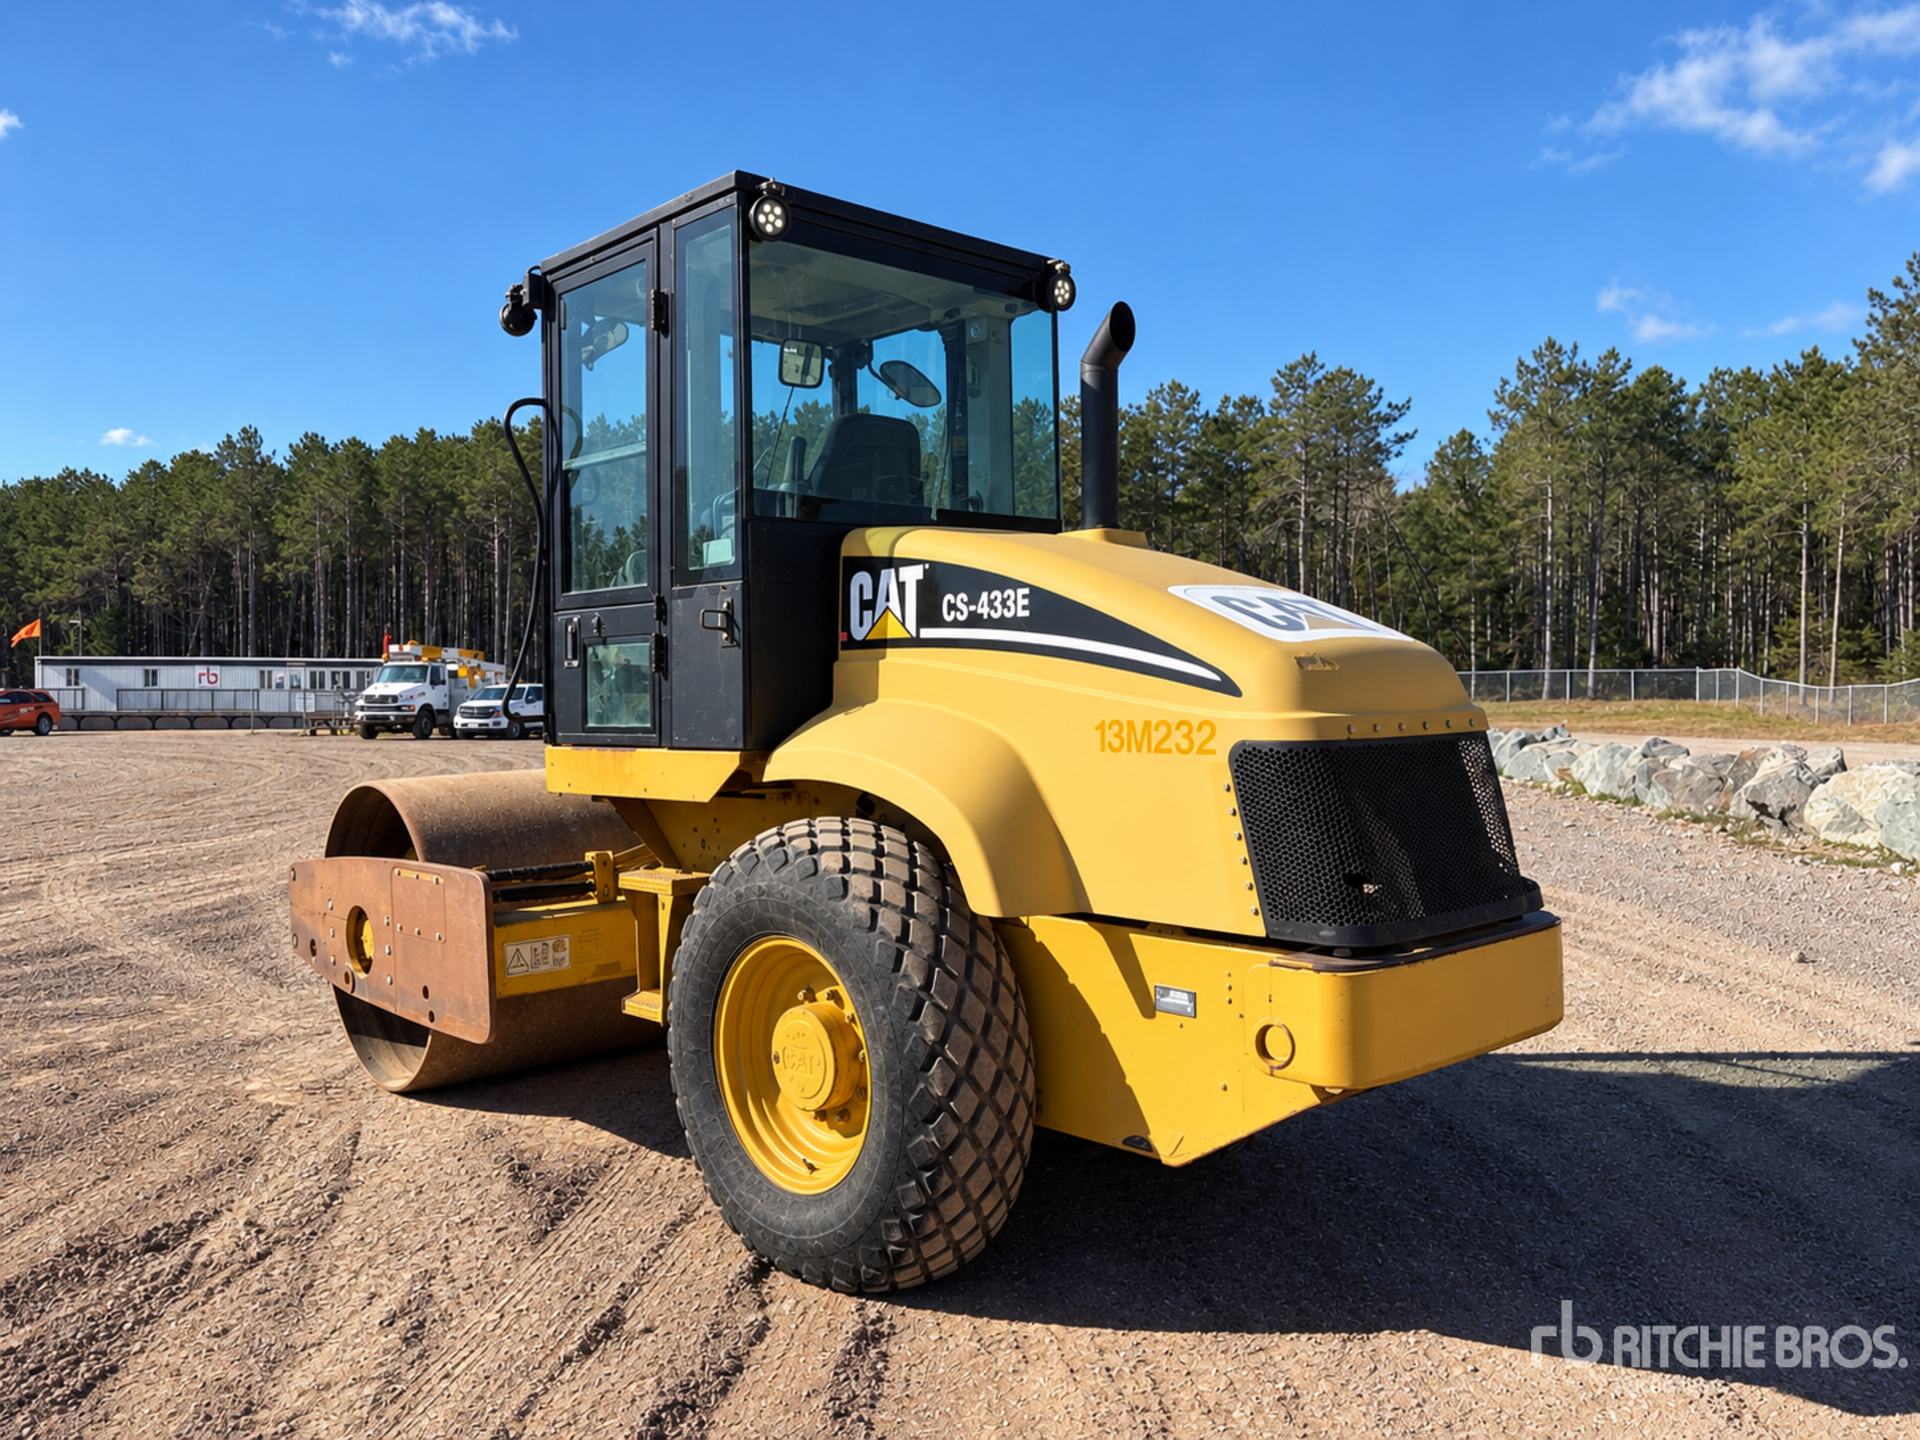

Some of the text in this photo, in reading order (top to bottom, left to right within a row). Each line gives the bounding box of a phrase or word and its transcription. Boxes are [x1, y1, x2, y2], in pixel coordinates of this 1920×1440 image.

[850, 563, 925, 641] CAT
[942, 587, 1030, 622] CS-433E
[1210, 595, 1380, 632] CAT
[198, 666, 219, 685] rb
[1094, 719, 1217, 755] 13M232
